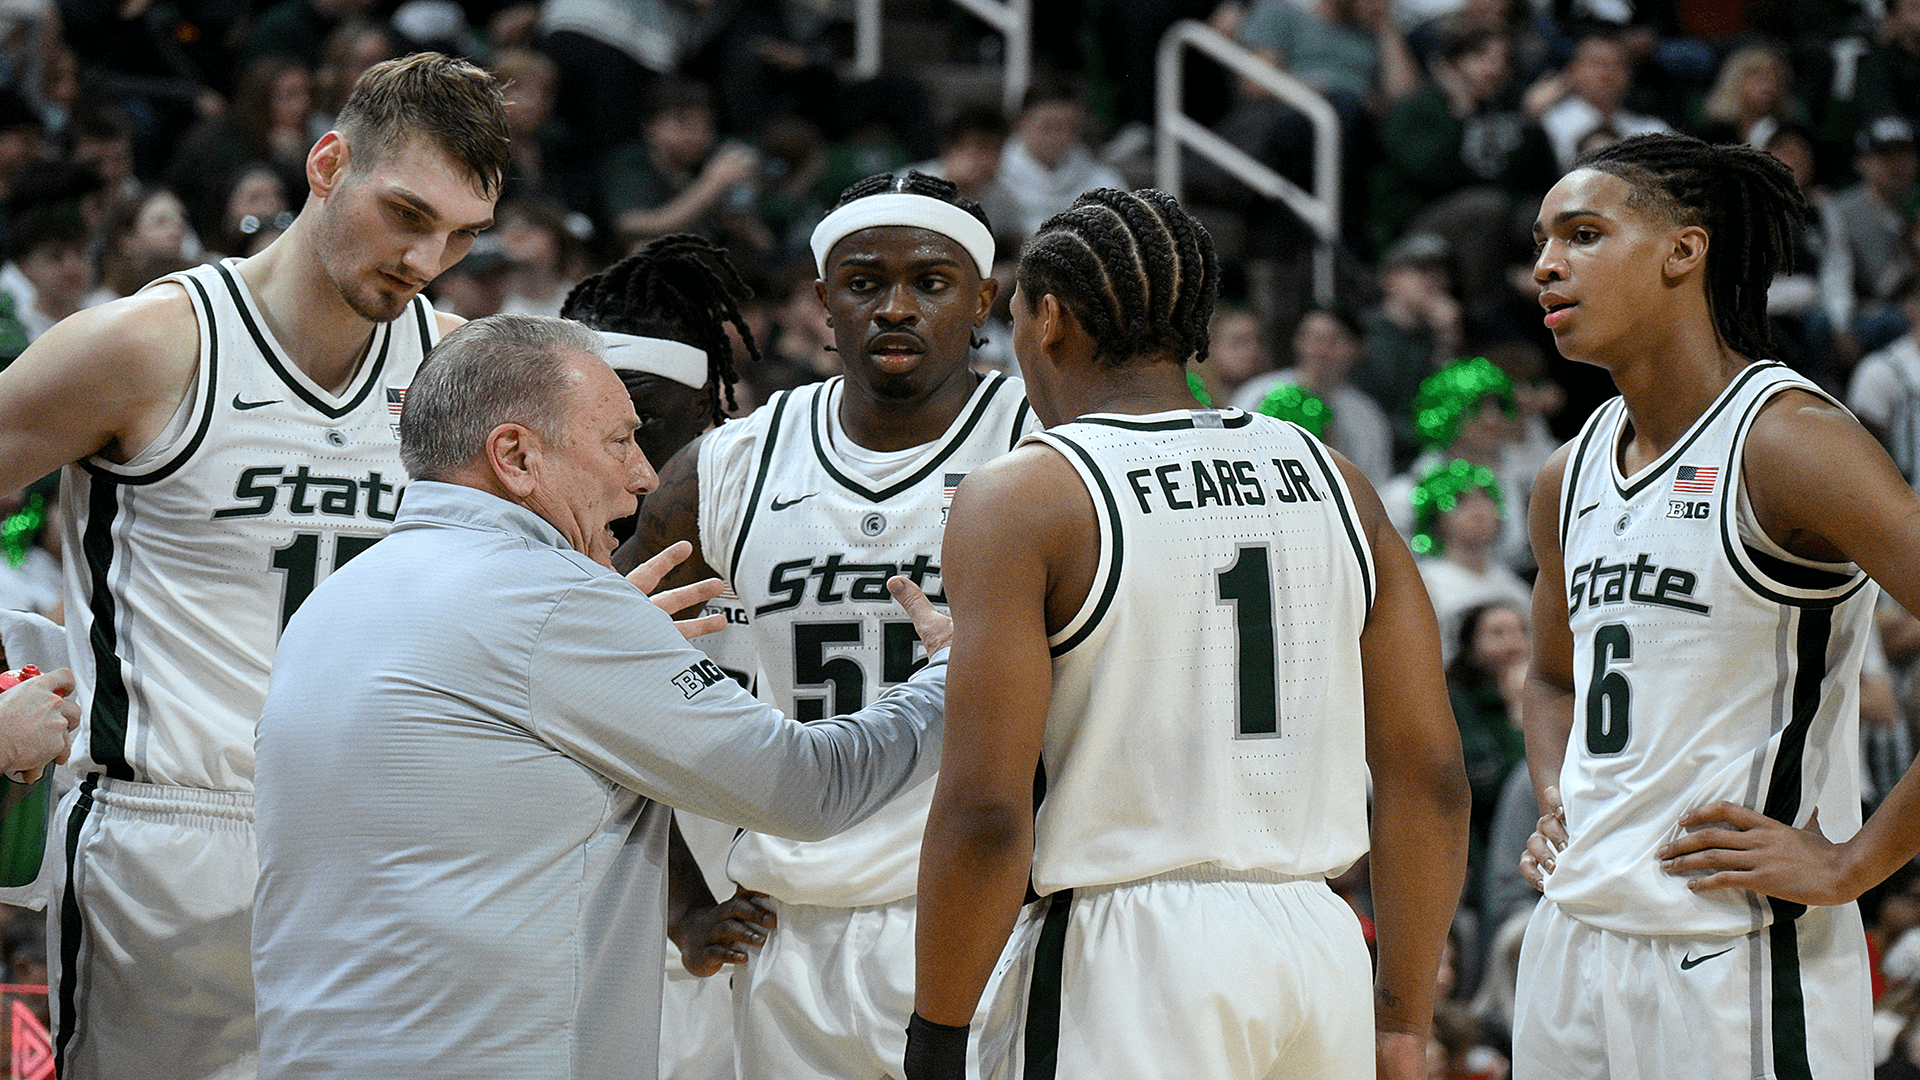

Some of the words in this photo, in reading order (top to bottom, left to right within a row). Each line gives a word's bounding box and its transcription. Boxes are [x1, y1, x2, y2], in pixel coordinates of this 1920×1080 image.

[210, 464, 406, 522] Stat
[1126, 458, 1266, 514] FEARS
[267, 529, 389, 642] 1
[754, 552, 950, 619] Stat
[1568, 552, 1713, 618] State
[1213, 541, 1281, 741] 1
[1584, 620, 1634, 759] 6
